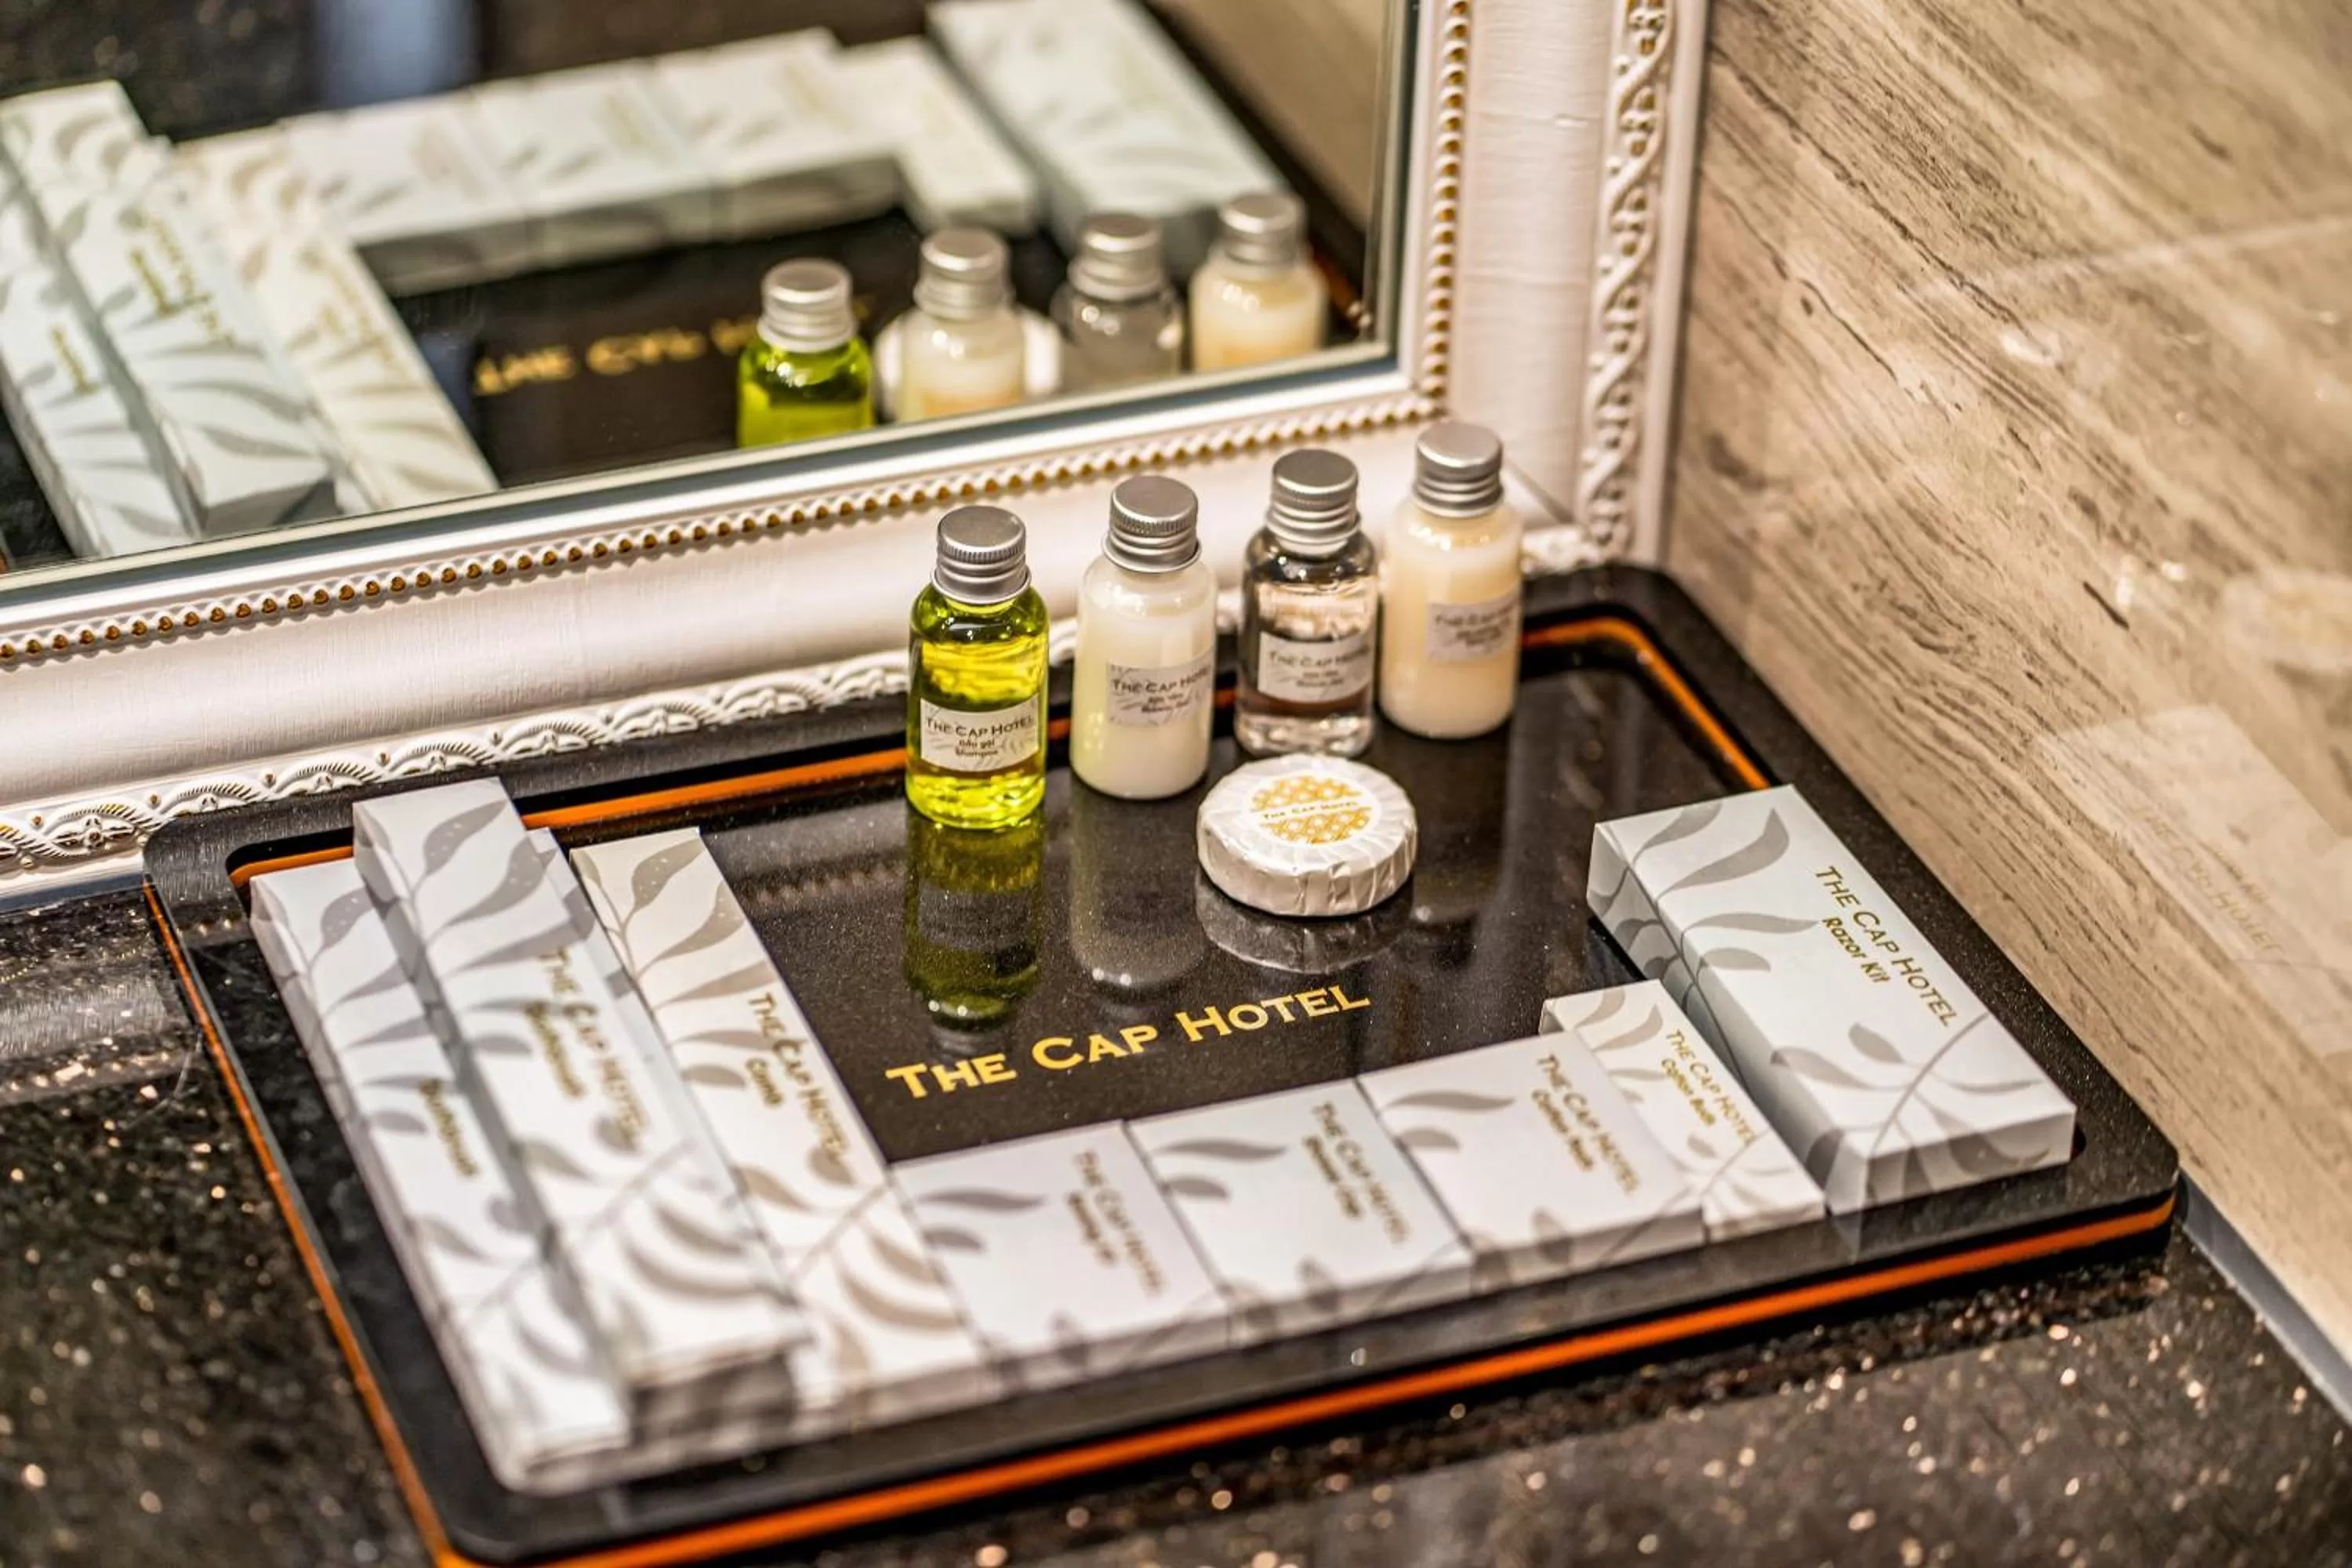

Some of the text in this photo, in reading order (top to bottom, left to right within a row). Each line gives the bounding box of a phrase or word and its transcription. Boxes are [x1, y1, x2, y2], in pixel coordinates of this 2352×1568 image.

[1112, 679, 1145, 695] THE
[1145, 681, 1177, 694] CAP
[924, 714, 1035, 739] THE CAP HOTEL
[1815, 865, 1958, 1028] THE CAP HOTEL
[1820, 915, 1892, 985] Razor Kit
[746, 991, 789, 1041] THE
[885, 984, 1372, 1098] THE CAP HOTEL
[1665, 1027, 1697, 1061] THE
[1689, 1061, 1722, 1094] CAP
